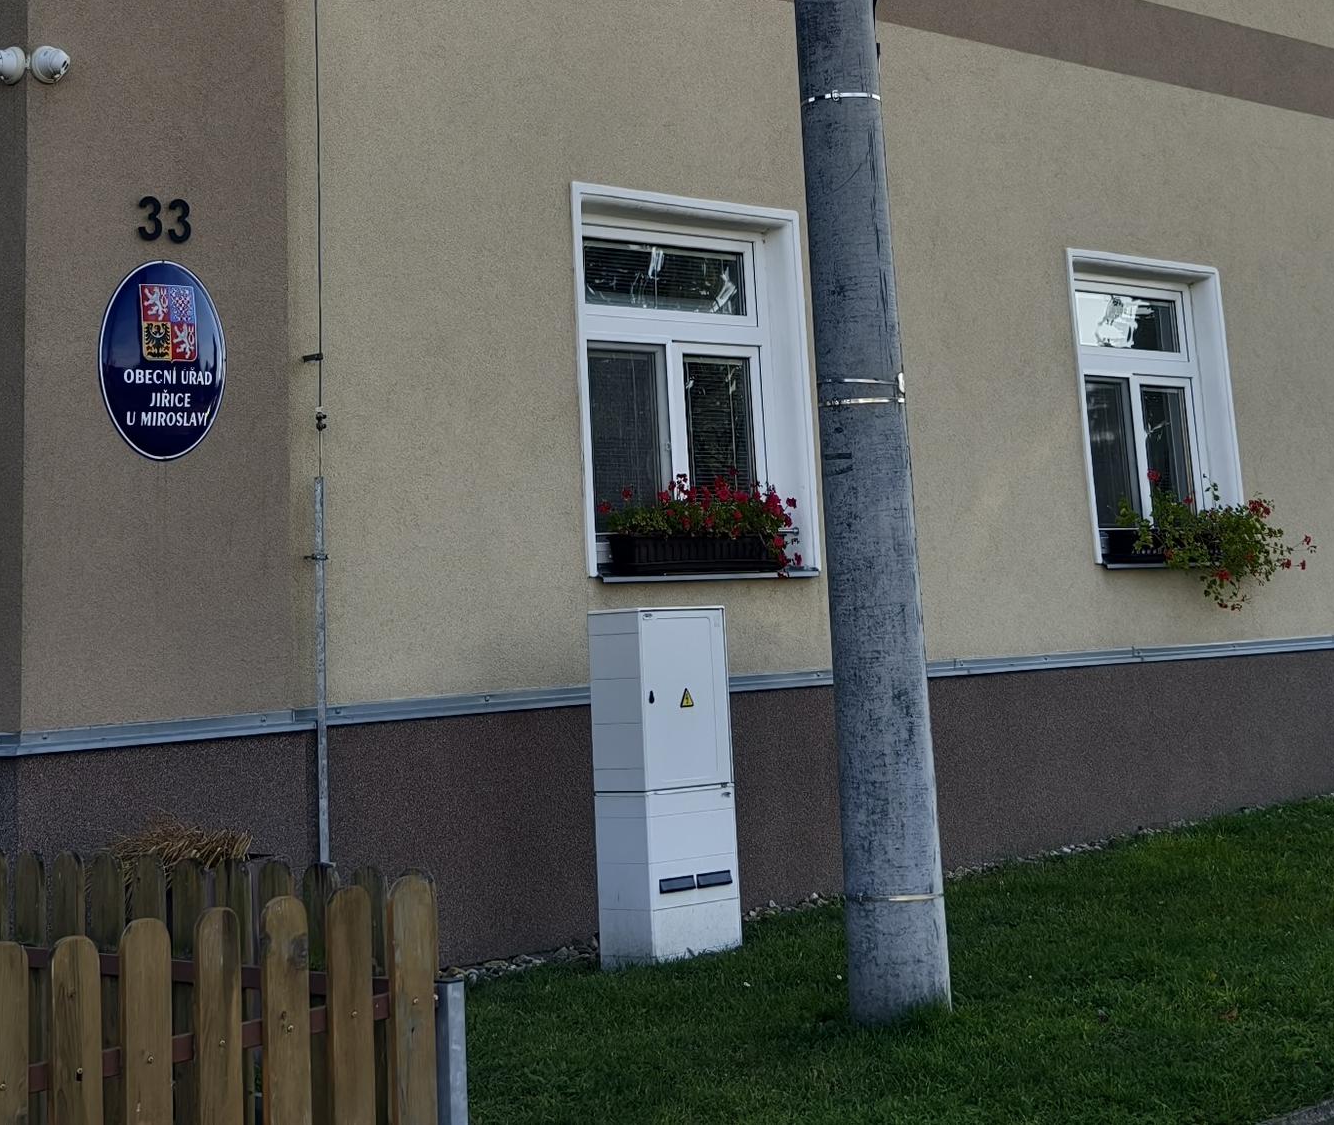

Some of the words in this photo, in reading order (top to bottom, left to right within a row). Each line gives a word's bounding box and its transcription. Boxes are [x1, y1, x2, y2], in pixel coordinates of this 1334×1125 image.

[138, 195, 192, 244] 33
[123, 367, 177, 385] OBECNÍ
[181, 367, 213, 386] ÚŘAD
[149, 389, 191, 408] JIŘICE
[126, 411, 136, 426] U
